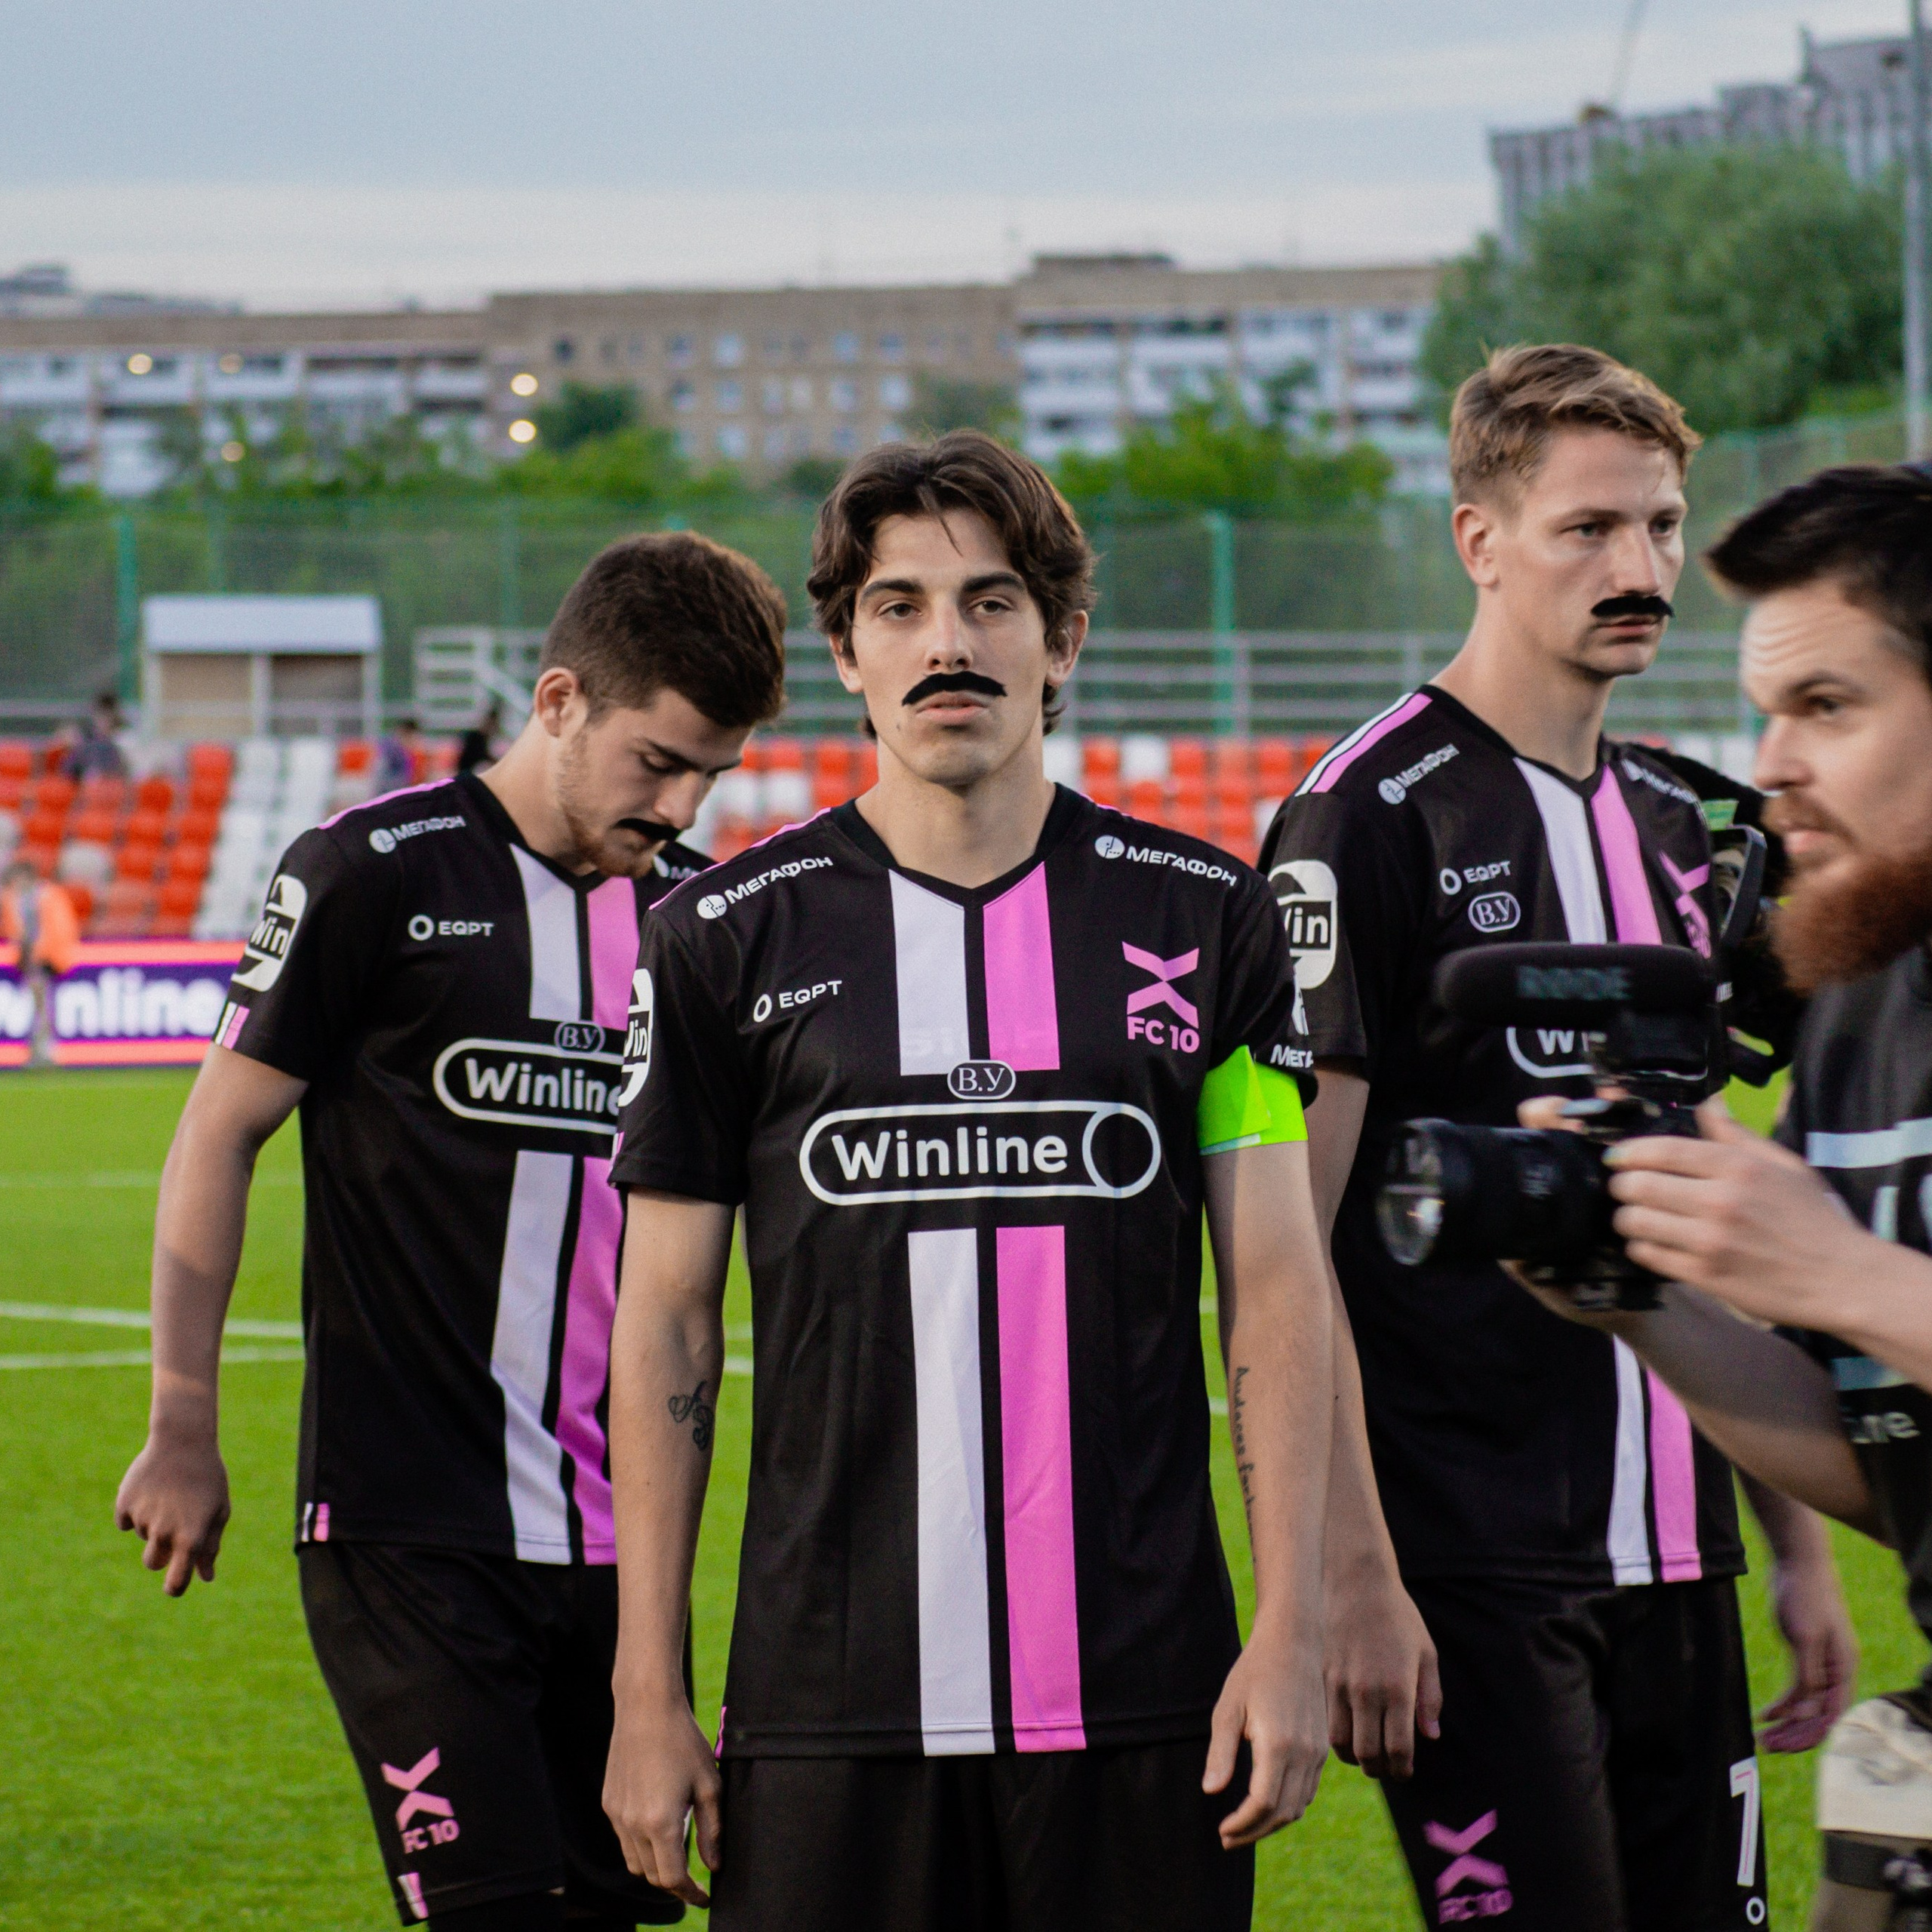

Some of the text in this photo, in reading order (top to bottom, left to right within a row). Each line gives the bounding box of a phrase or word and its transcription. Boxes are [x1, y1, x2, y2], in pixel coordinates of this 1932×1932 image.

[724, 856, 833, 904] МЕГАФОН
[1126, 845, 1238, 887] МЕГАФОН
[1463, 860, 1511, 884] EQPT
[438, 920, 494, 937] EQPT
[779, 980, 842, 1009] EQPT
[1127, 1016, 1201, 1054] FC 10
[831, 1127, 1068, 1181] Winline
